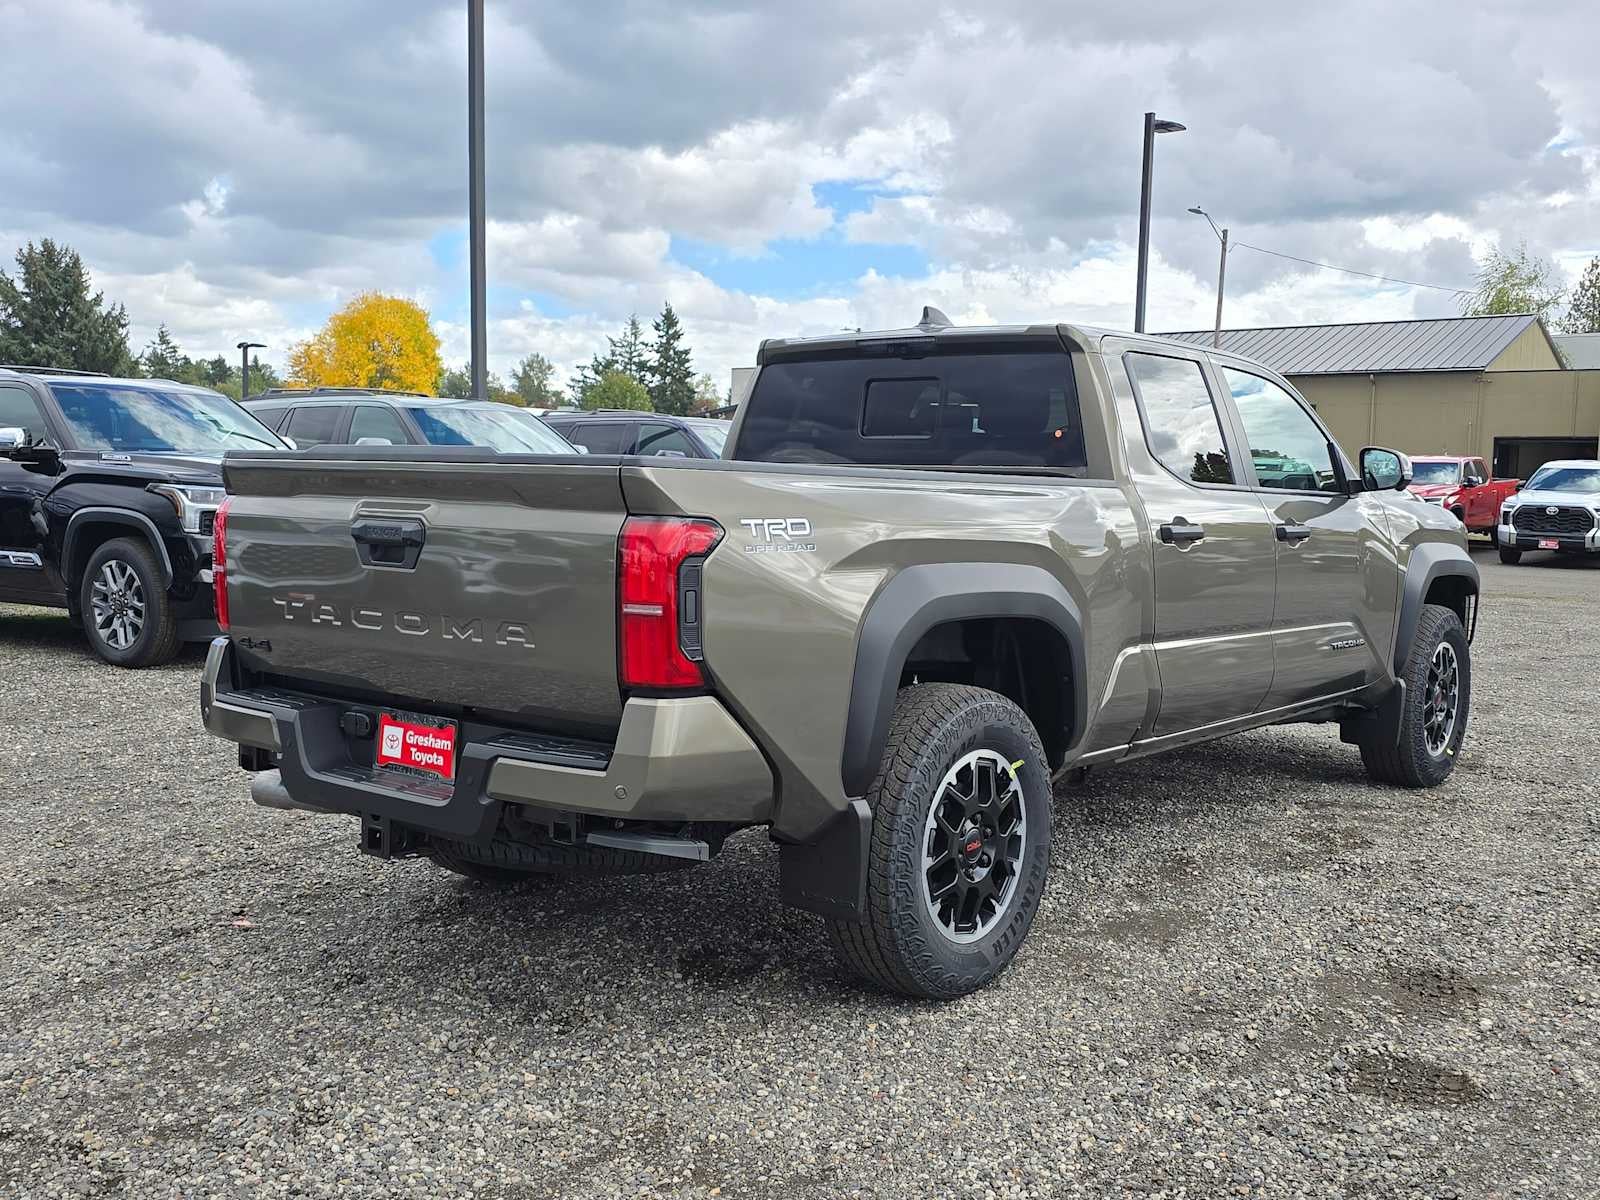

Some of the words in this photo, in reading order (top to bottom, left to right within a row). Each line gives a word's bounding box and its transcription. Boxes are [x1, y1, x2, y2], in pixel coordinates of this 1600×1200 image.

[740, 518, 811, 542] TRD
[744, 543, 774, 554] OFF
[776, 543, 817, 553] ROAD
[272, 597, 536, 648] TACOMA
[405, 730, 452, 750] Gresham
[410, 747, 444, 766] Toyota
